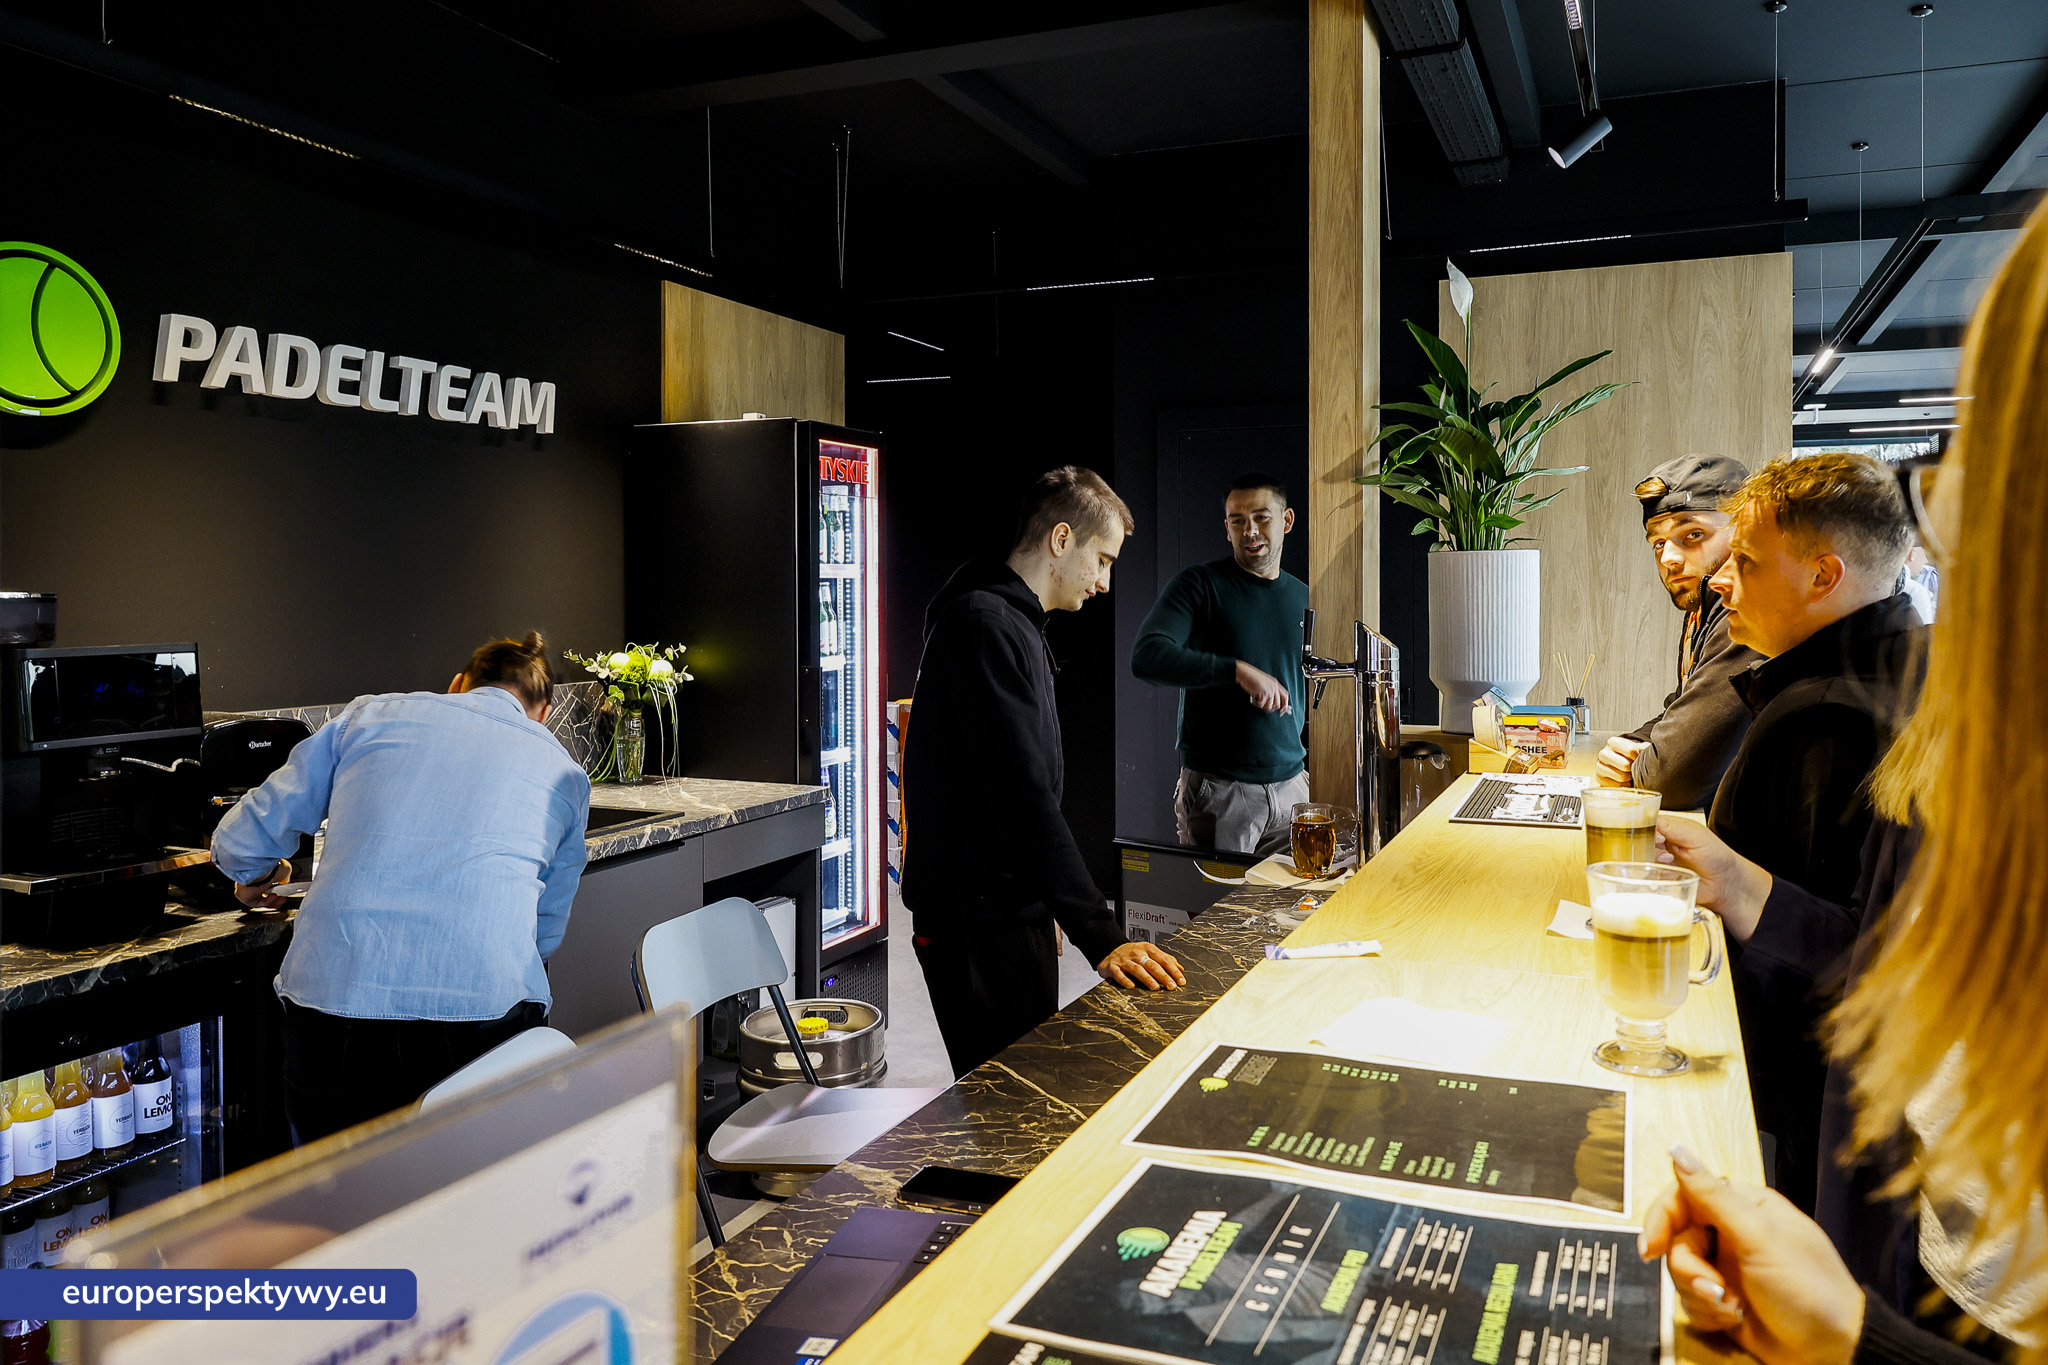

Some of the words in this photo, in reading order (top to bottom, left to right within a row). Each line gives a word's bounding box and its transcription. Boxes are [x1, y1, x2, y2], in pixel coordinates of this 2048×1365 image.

[152, 313, 556, 434] PADELTEAM
[819, 456, 869, 484] TYSKIE
[1128, 908, 1166, 924] FlexiDraft
[155, 1092, 171, 1106] ON
[1138, 1210, 1228, 1299] AKADEMIA
